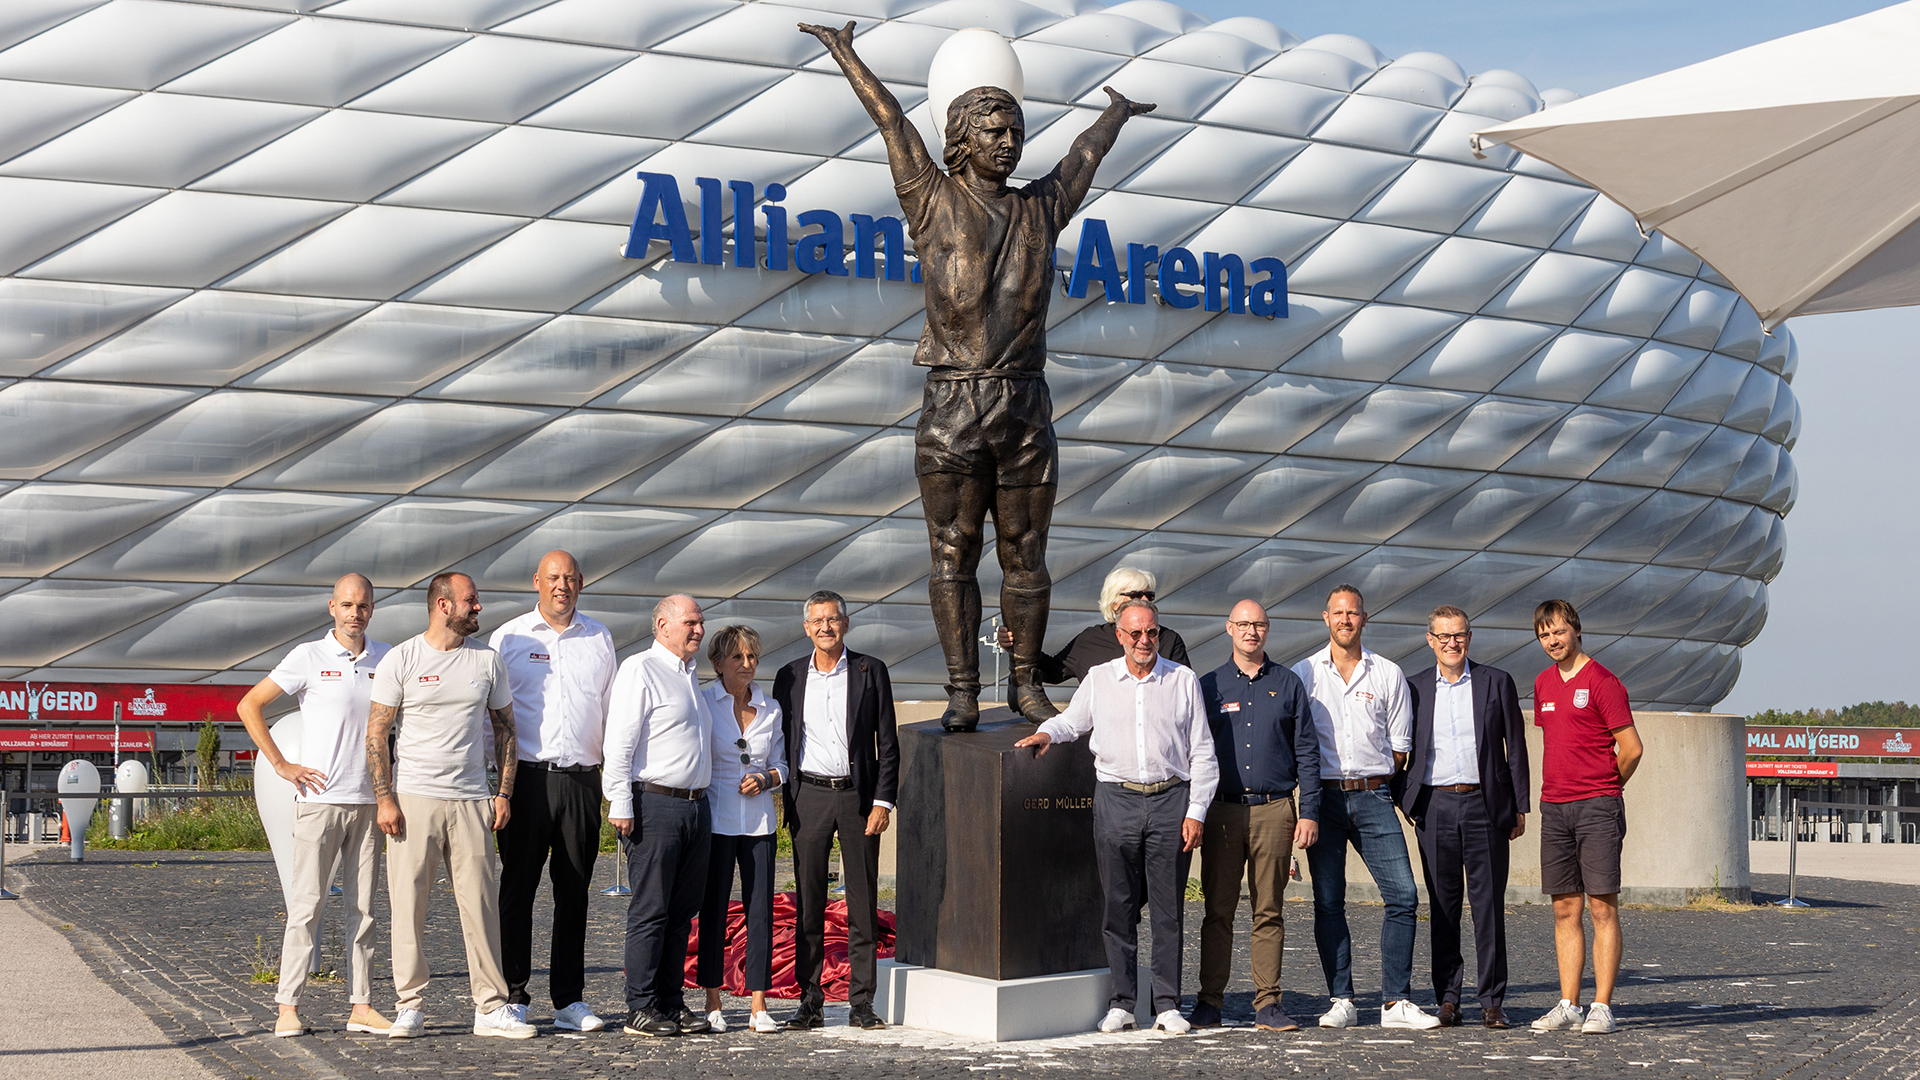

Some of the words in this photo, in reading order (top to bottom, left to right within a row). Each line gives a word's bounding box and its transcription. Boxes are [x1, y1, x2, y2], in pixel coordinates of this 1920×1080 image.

[626, 171, 923, 283] Allian
[1067, 218, 1289, 319] Arena
[42, 691, 98, 711] GERD
[1747, 733, 1780, 748] MAL
[1784, 734, 1806, 749] AN
[1818, 735, 1860, 749] GERD
[1024, 798, 1050, 810] GERD
[1055, 796, 1093, 809] MÜLLER
